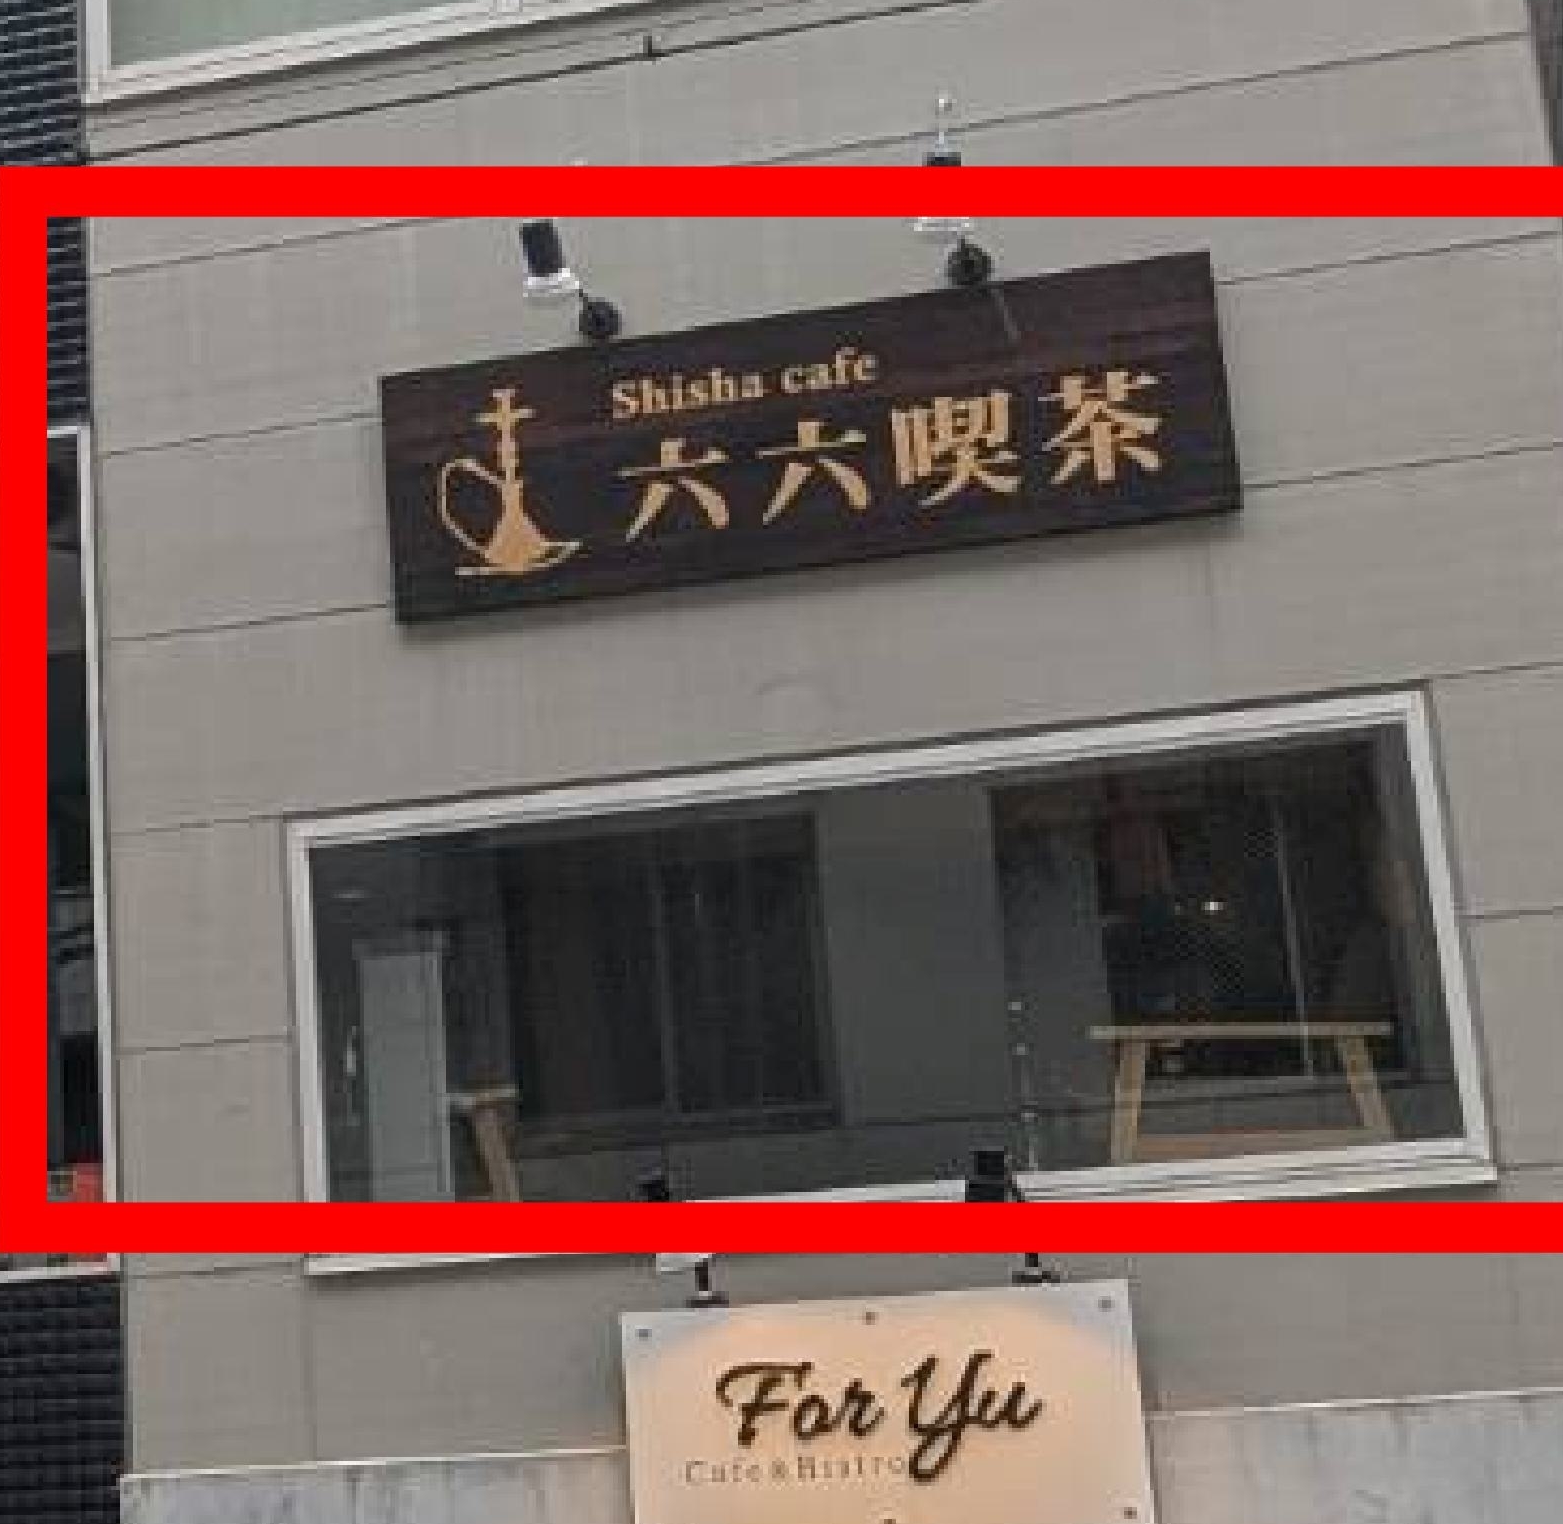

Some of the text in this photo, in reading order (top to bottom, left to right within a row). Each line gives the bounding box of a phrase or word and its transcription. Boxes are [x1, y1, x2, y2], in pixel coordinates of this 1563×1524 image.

[610, 345, 879, 421] Shisha cafe
[614, 368, 1166, 544] 六六喫茶
[714, 1349, 1044, 1482] For Yu
